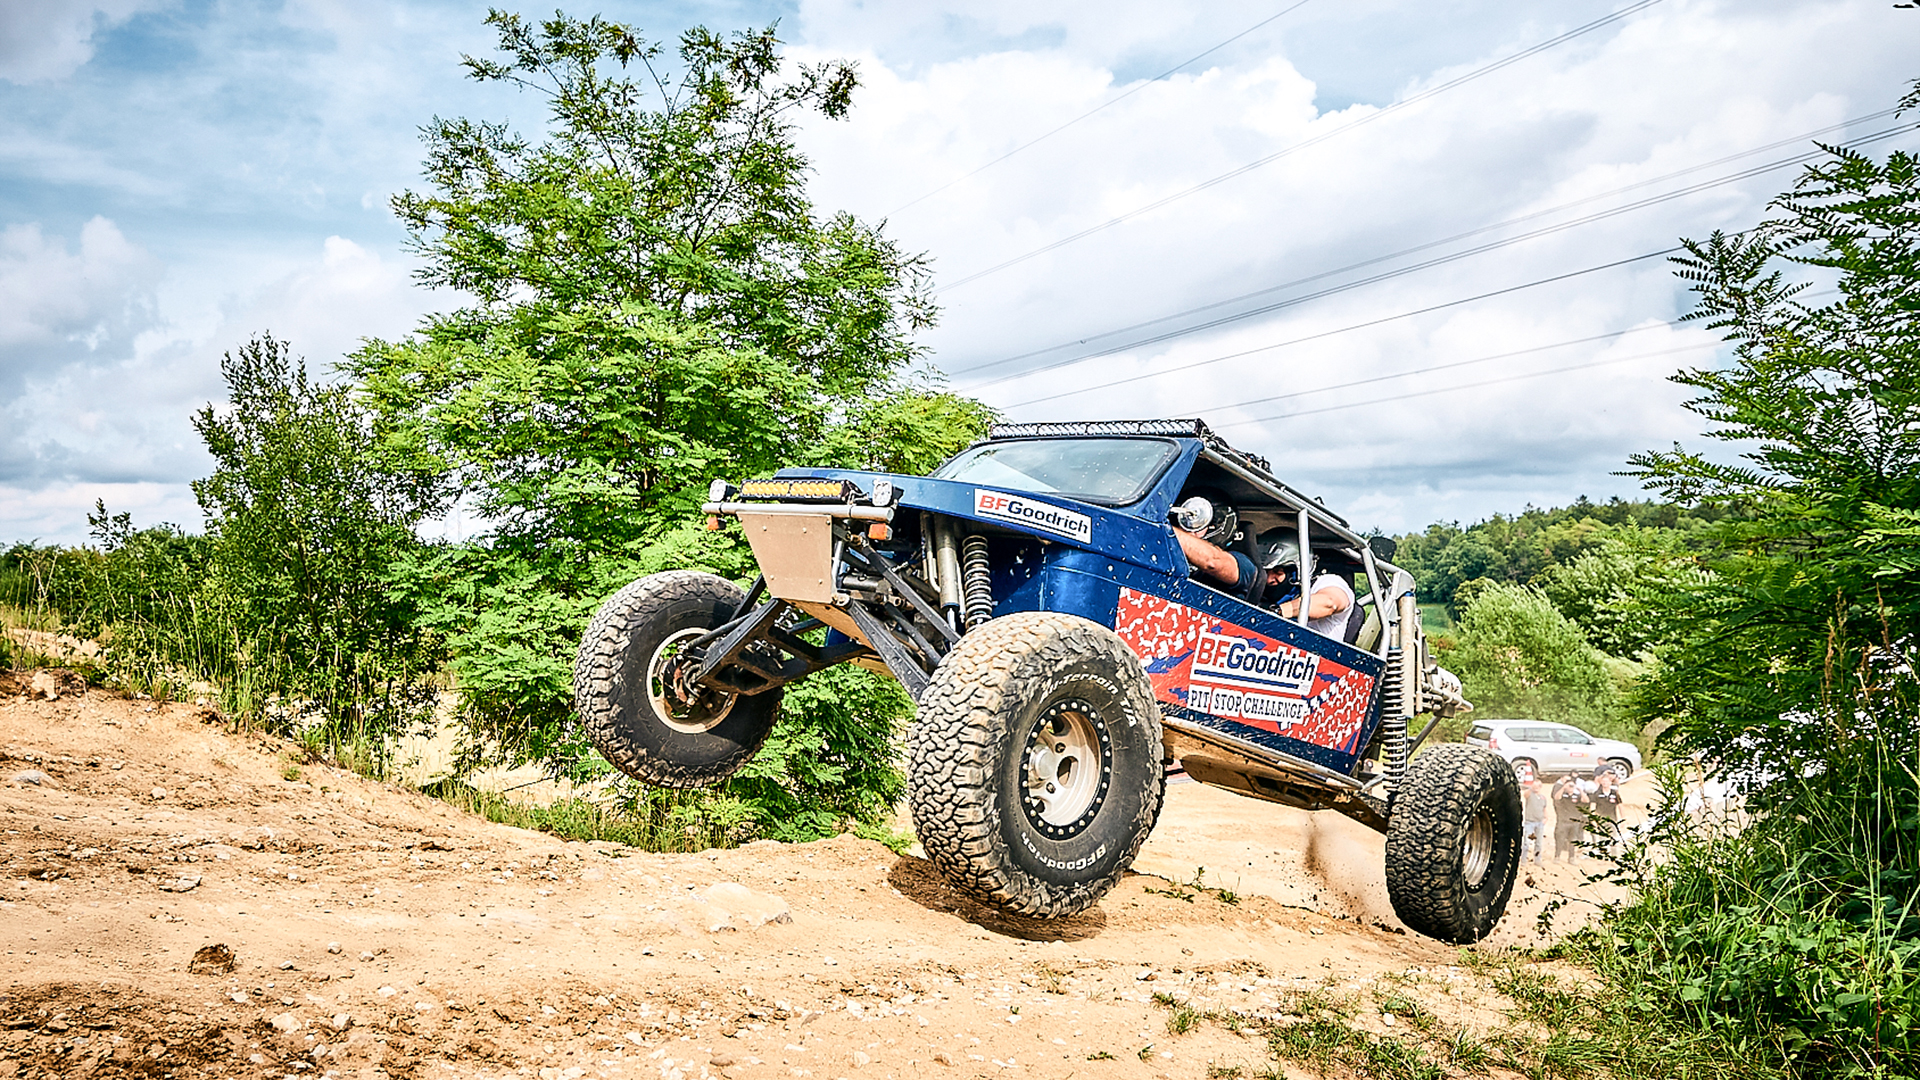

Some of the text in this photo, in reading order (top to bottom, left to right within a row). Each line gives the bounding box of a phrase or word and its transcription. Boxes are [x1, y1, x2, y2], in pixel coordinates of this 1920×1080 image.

[979, 495, 1088, 534] BFGoodrich
[1120, 697, 1137, 727] T/A
[1190, 690, 1304, 719] PIT STOP CHALLENGE
[1021, 832, 1107, 870] BFGoodrich
